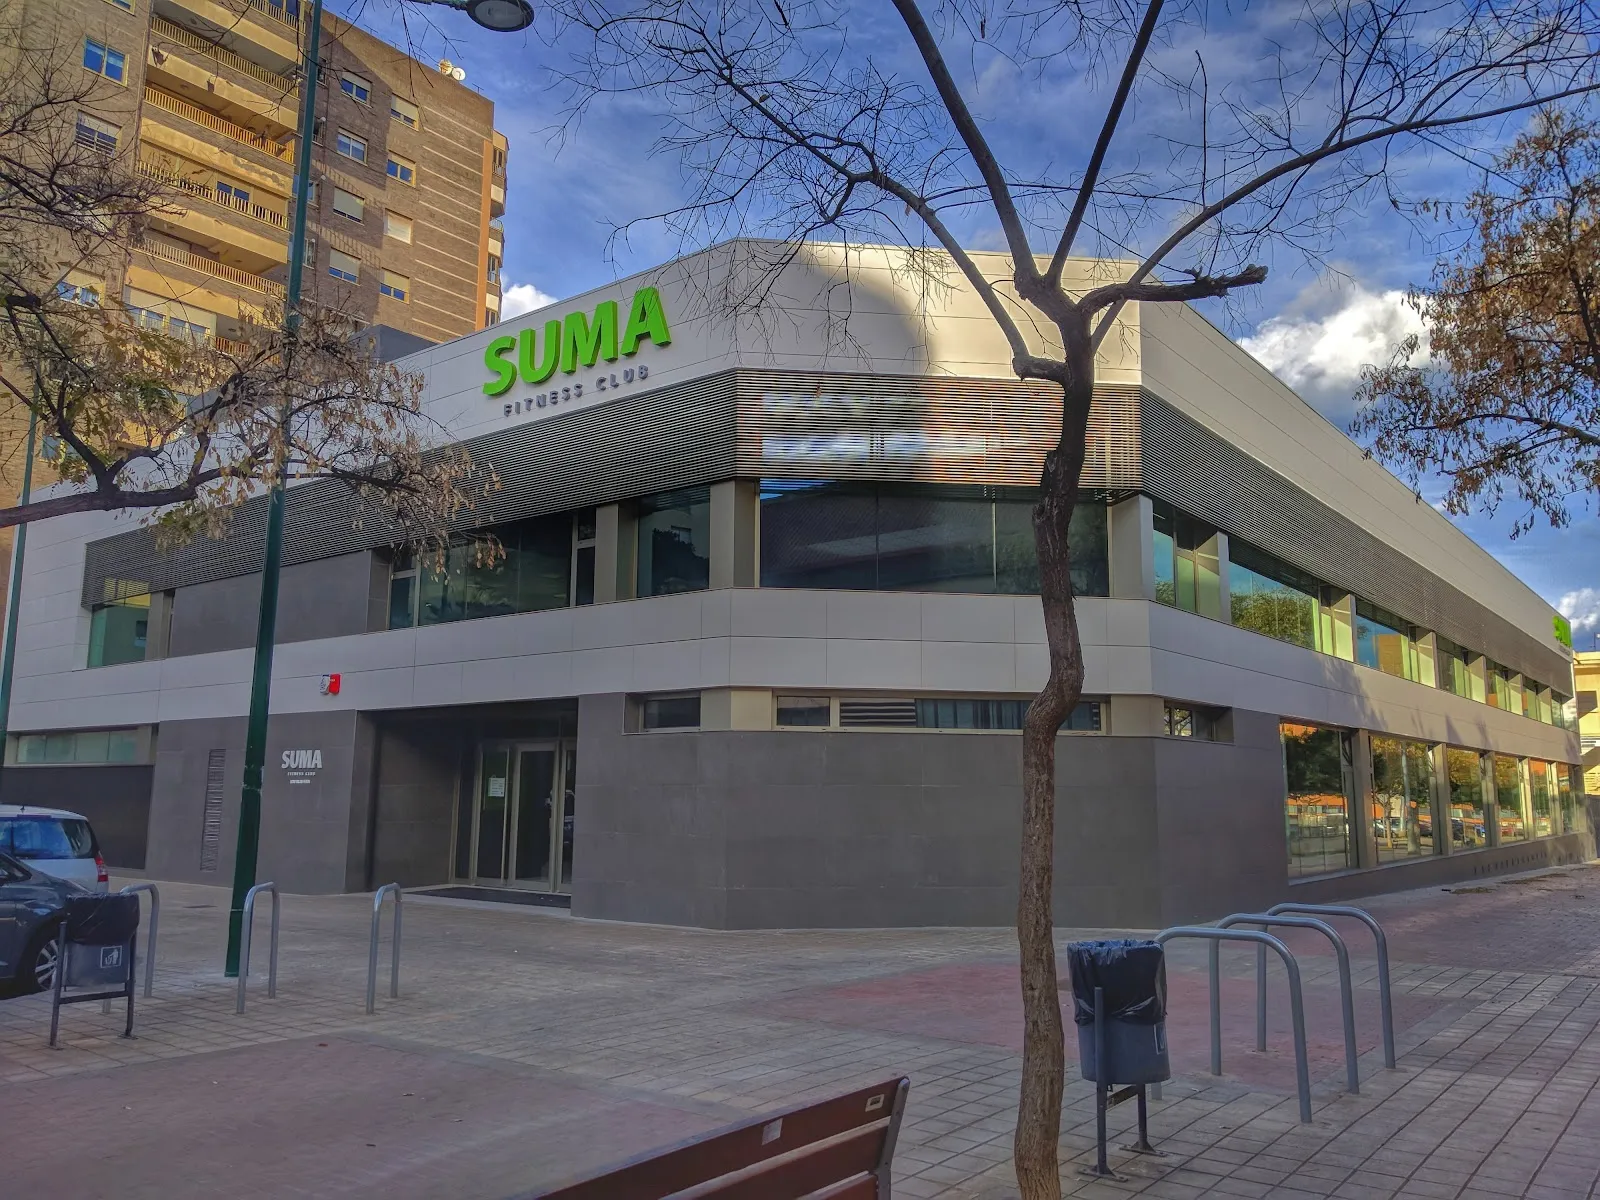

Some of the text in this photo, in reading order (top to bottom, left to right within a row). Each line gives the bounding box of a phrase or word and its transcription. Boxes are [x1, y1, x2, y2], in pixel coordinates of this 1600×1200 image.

[482, 286, 672, 397] SUMA
[503, 364, 649, 417] FITNESS CLUB
[281, 749, 323, 769] SUMA
